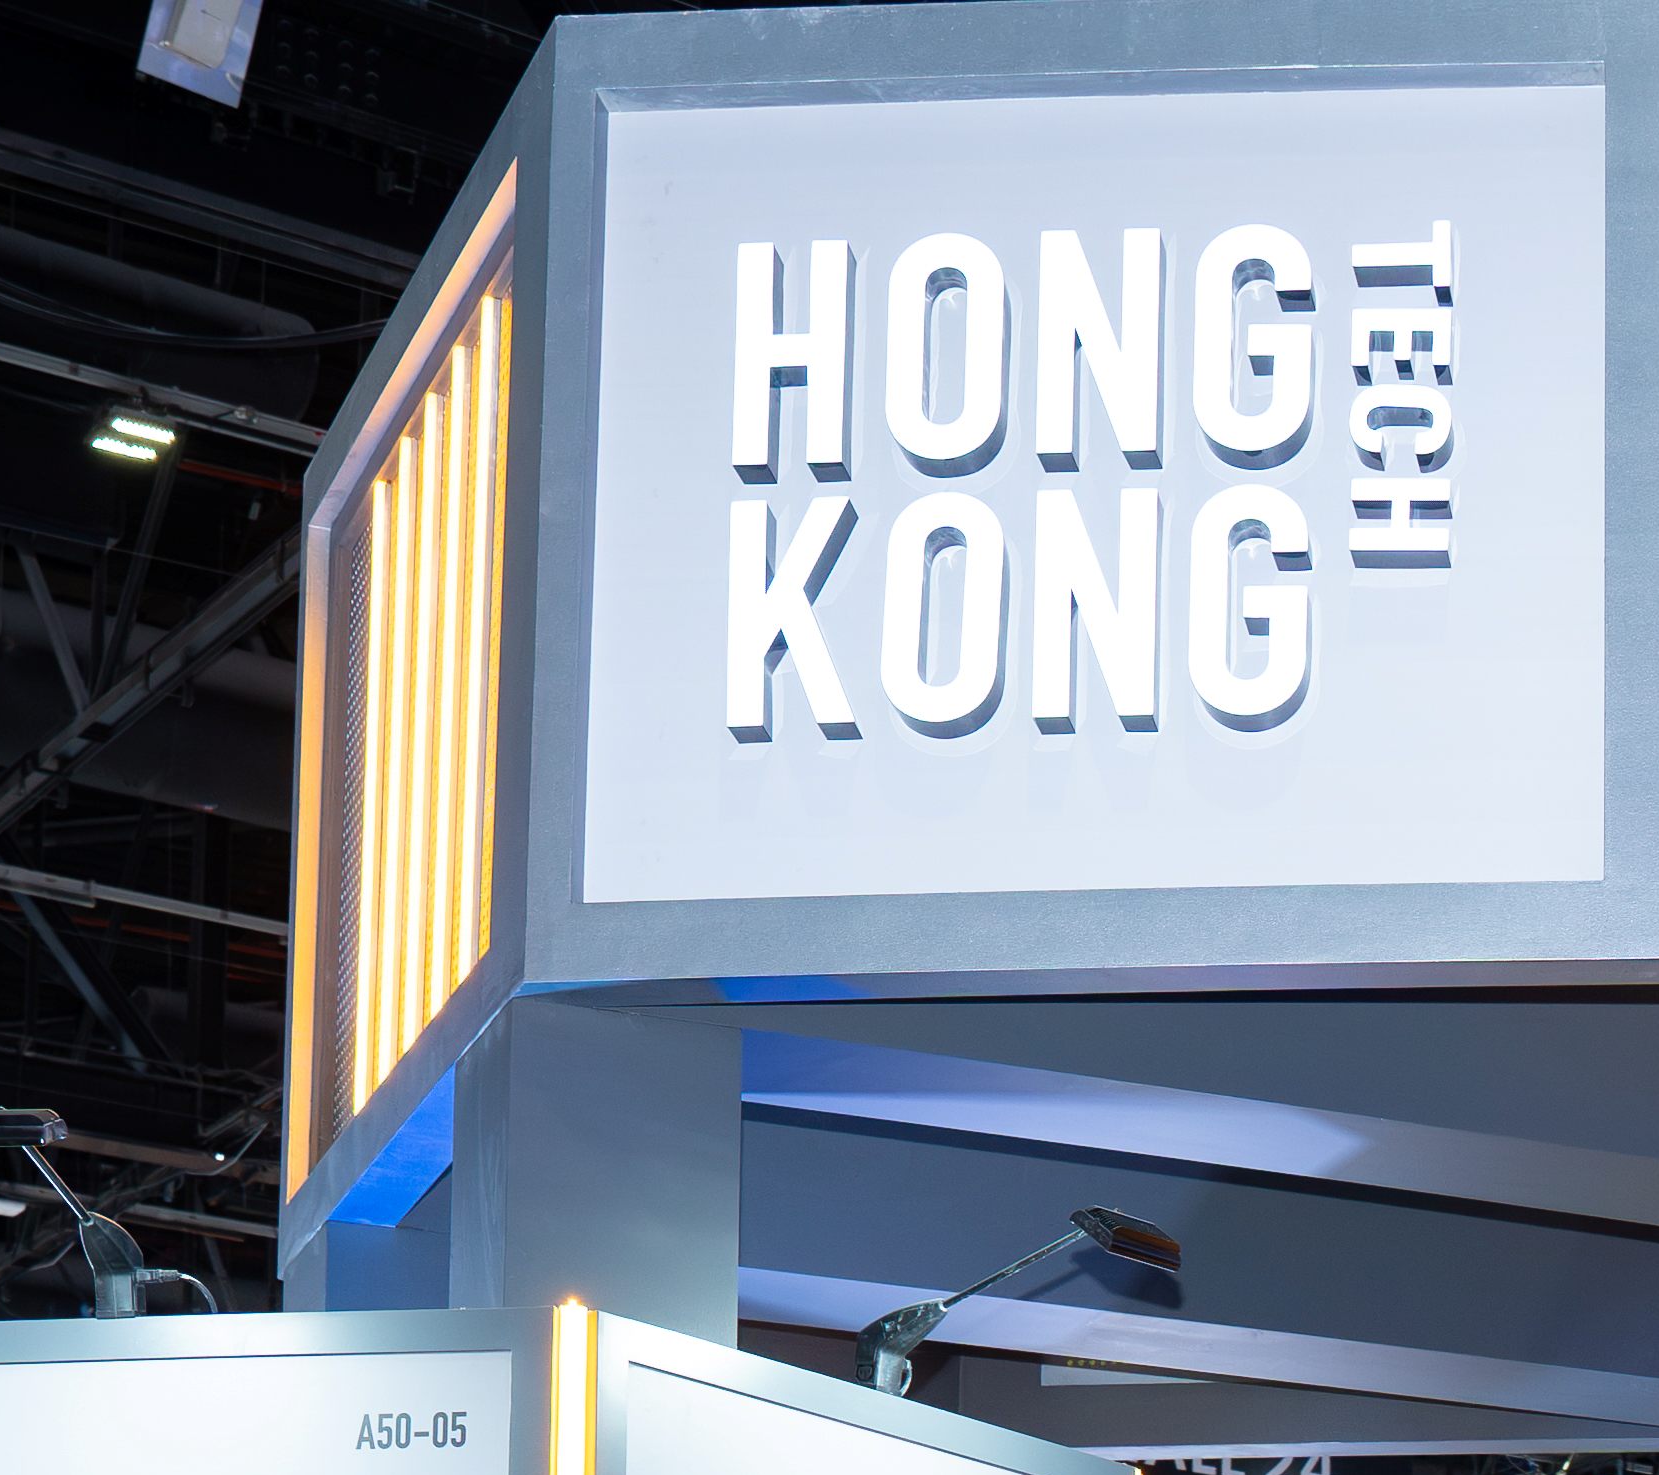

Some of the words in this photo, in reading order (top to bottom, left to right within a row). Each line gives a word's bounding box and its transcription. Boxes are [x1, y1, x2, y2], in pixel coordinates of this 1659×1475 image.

[731, 222, 1319, 484] HONG
[1347, 219, 1454, 569] TECH
[727, 483, 1314, 743] KONG
[357, 1413, 467, 1450] A50-05
